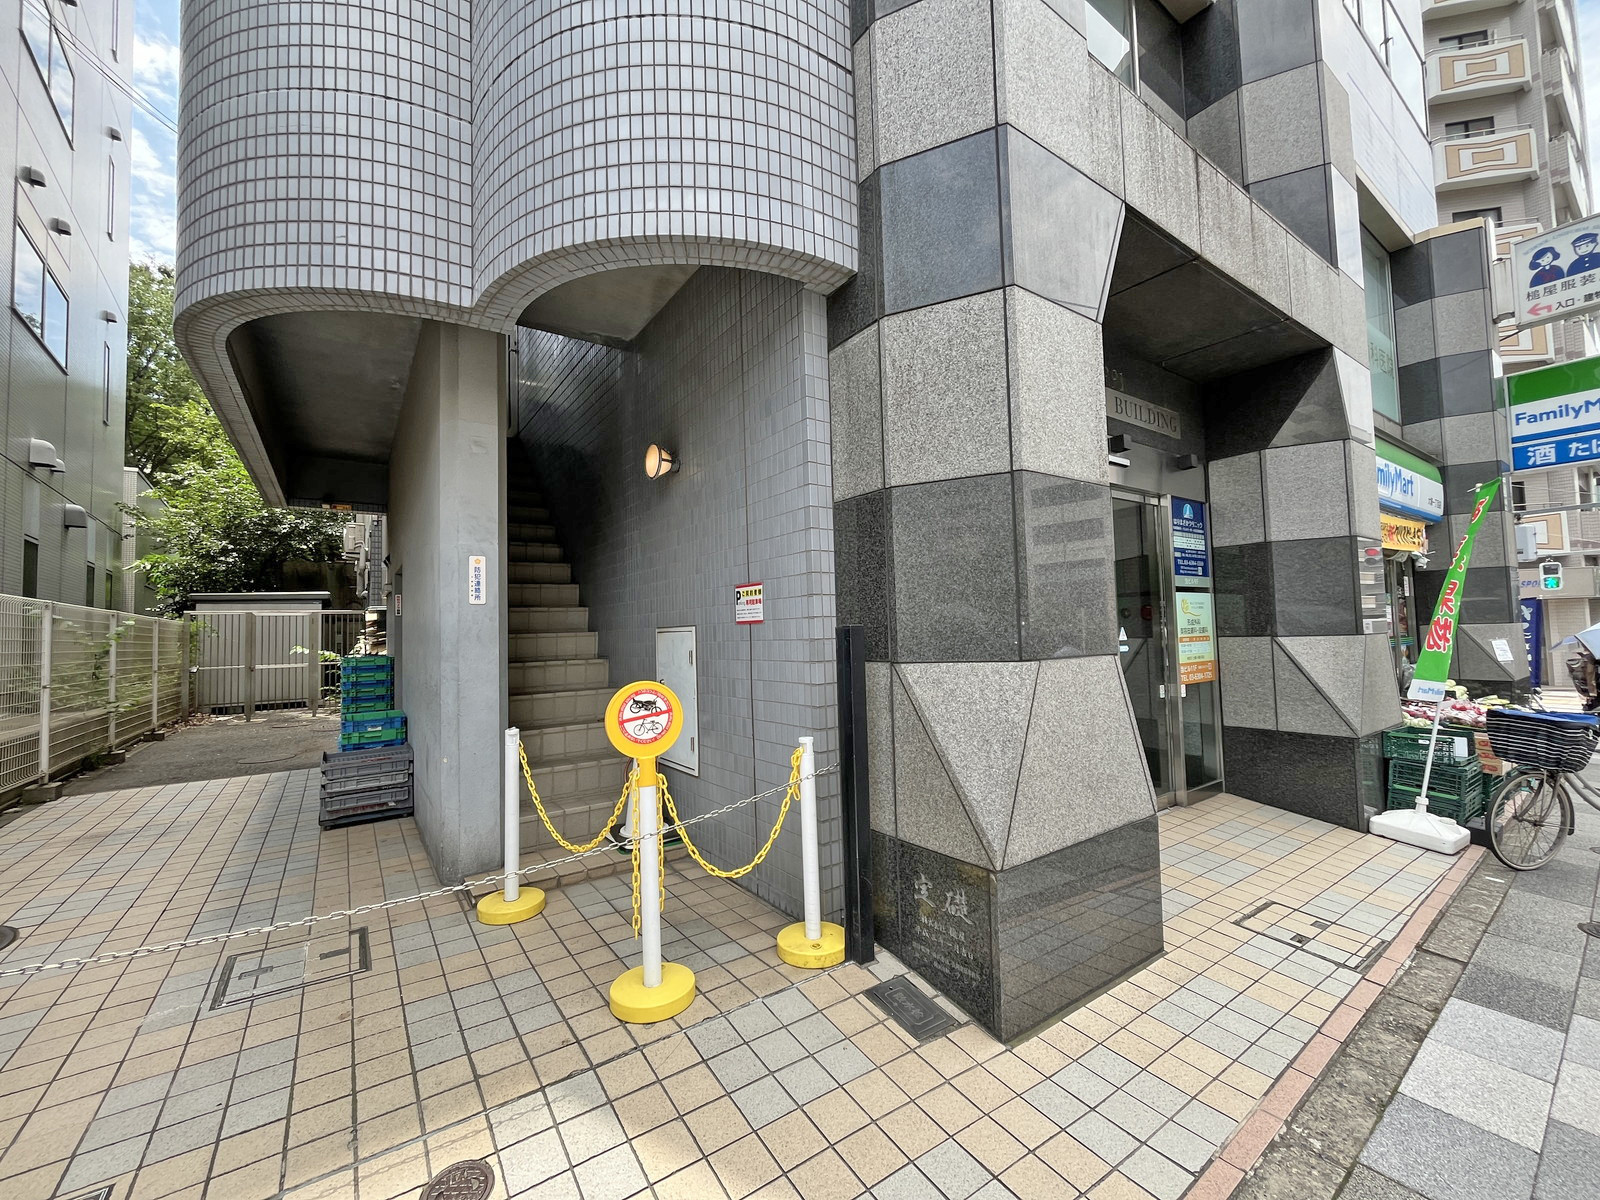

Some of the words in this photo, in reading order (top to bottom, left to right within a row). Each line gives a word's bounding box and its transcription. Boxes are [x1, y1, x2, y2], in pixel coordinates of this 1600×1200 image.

[1114, 396, 1177, 432] BUILDING
[1527, 443, 1556, 466] 酒
[1376, 463, 1414, 497] milyMart
[1520, 580, 1540, 589] SPO
